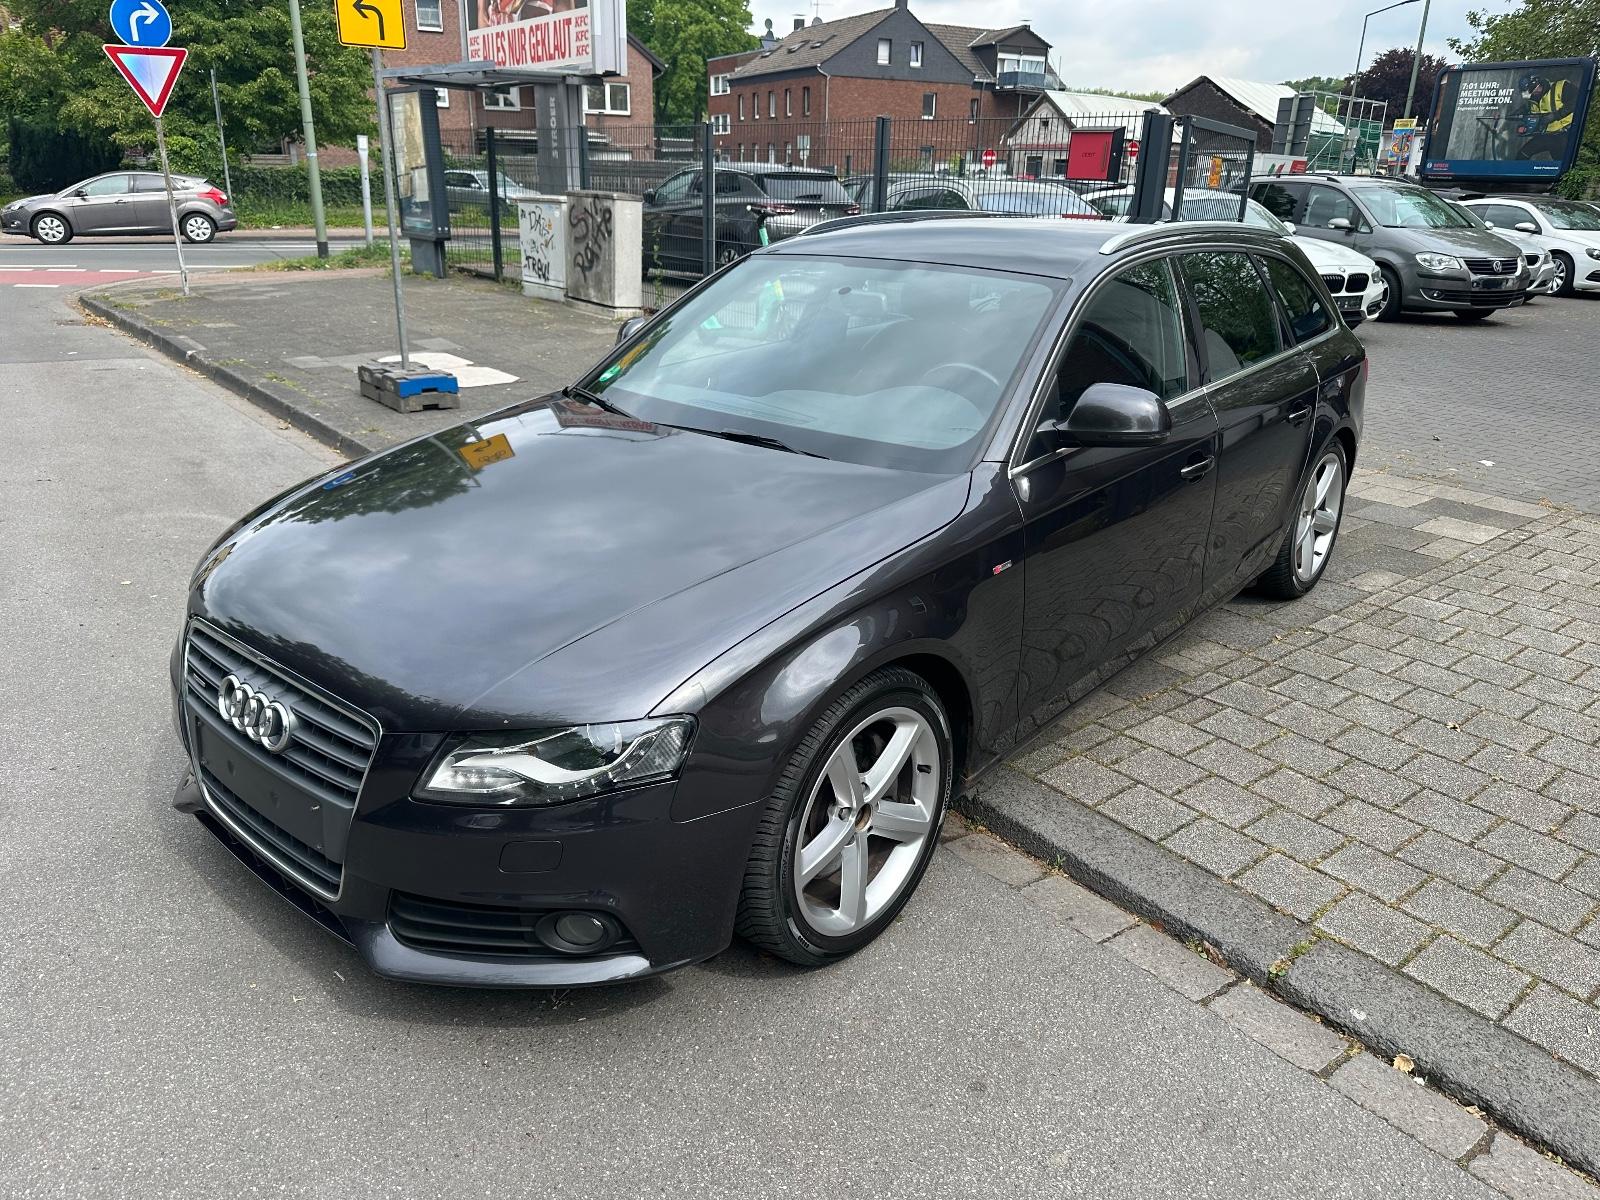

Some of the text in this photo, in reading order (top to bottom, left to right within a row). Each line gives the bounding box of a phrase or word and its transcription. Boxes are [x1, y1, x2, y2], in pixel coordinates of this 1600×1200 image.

[575, 15, 589, 28] KFC
[469, 36, 480, 46] KFC
[575, 29, 589, 42] KFC
[482, 17, 572, 66] ALLES NUR GEKLAUT
[470, 48, 480, 59] KFC
[576, 44, 590, 57] KFC
[1462, 81, 1500, 90] 7:01 UHR:
[1460, 88, 1515, 98] MEETING MIT
[1458, 96, 1513, 105] STAHLBETON.
